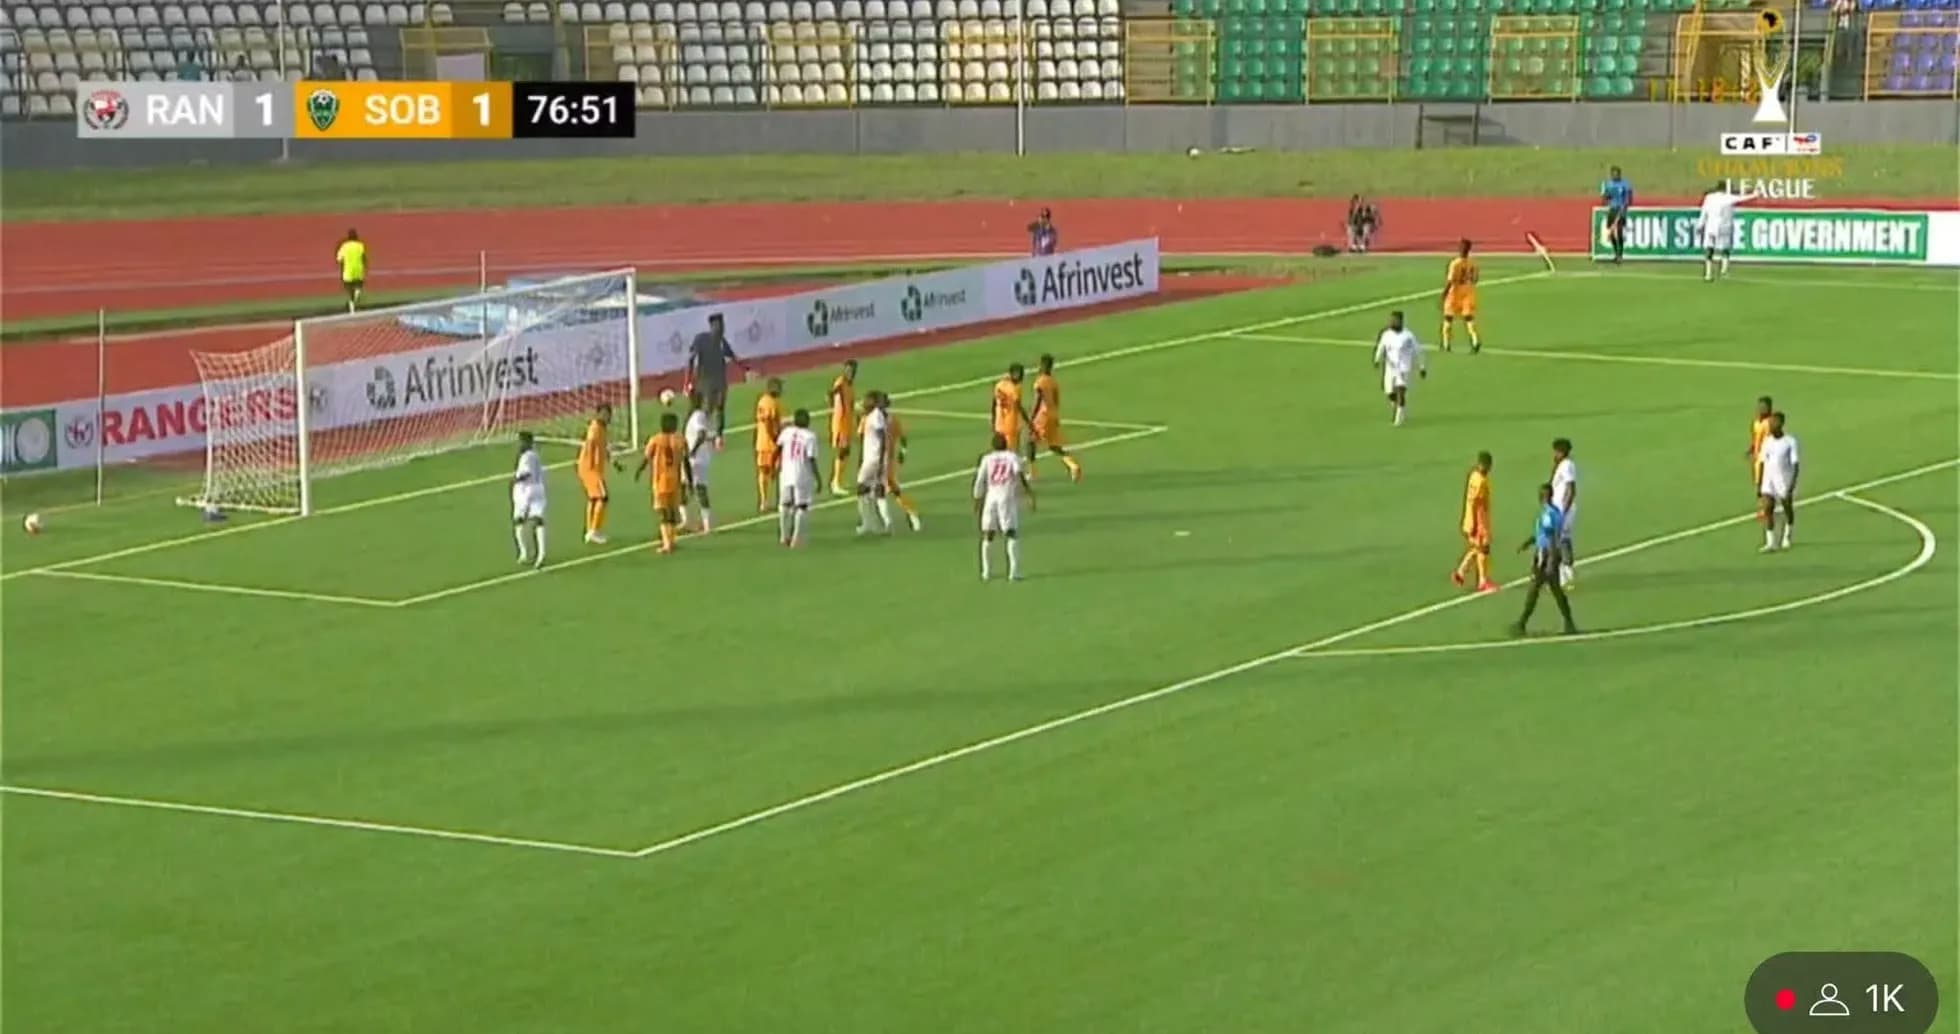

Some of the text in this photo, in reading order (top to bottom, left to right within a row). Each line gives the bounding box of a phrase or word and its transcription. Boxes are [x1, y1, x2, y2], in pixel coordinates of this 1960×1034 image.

[1752, 215, 1922, 252] GOVERNMENT
[1042, 251, 1145, 303] Afrinvest
[404, 346, 539, 406] Afrinvest
[98, 386, 297, 447] RANGERS
